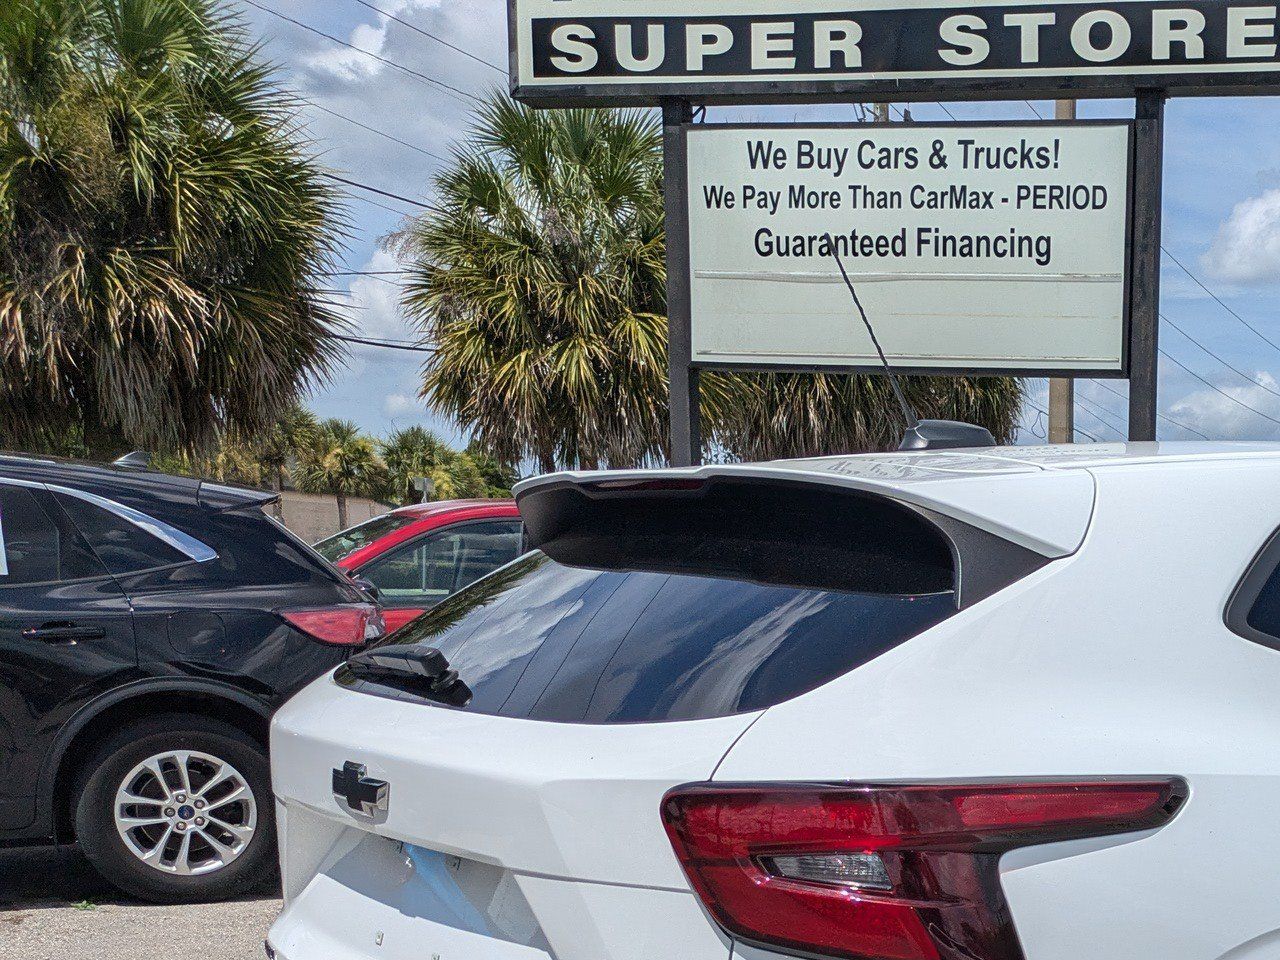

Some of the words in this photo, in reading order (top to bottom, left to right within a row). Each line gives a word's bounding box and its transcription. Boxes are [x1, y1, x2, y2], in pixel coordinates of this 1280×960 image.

[550, 20, 863, 73] SUPER
[938, 6, 1279, 66] STORE
[746, 140, 787, 170] We
[796, 140, 849, 178] Buy
[857, 139, 919, 170] Cars
[928, 139, 949, 170] &
[957, 138, 1060, 170] Trucks!
[702, 184, 736, 210] We
[742, 184, 782, 216] Pay
[788, 184, 841, 210] More
[847, 184, 902, 210] Than
[909, 184, 995, 210] CarMax
[1016, 184, 1108, 210] PERIOD
[754, 227, 907, 258] Guaranteed
[916, 227, 1051, 267] Financing
